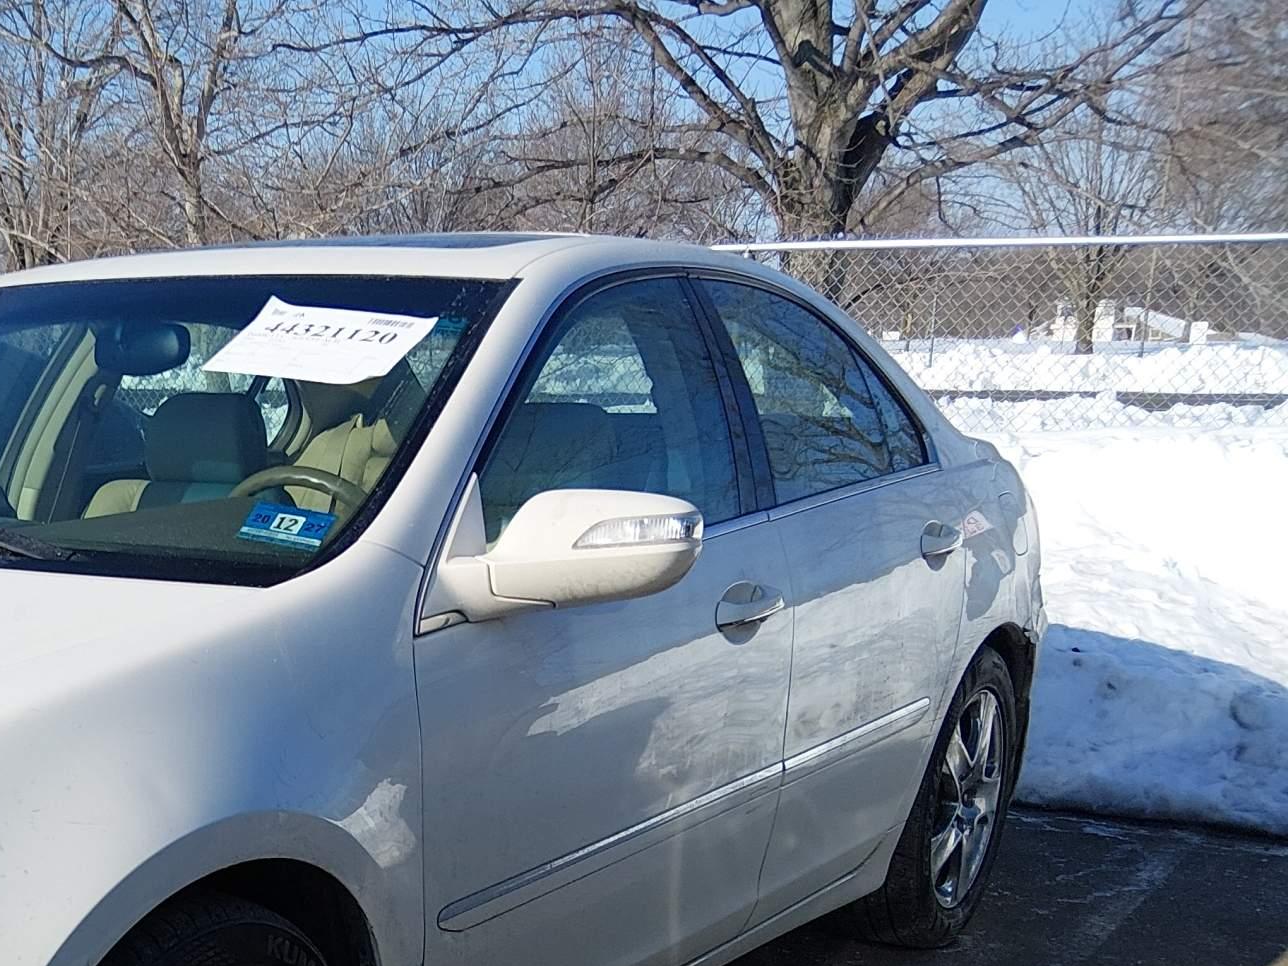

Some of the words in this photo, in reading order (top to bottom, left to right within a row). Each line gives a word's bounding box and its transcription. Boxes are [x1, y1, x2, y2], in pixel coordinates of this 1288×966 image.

[264, 321, 398, 344] 44321120
[253, 513, 271, 524] 20
[273, 516, 299, 531] 12
[303, 522, 327, 533] 27
